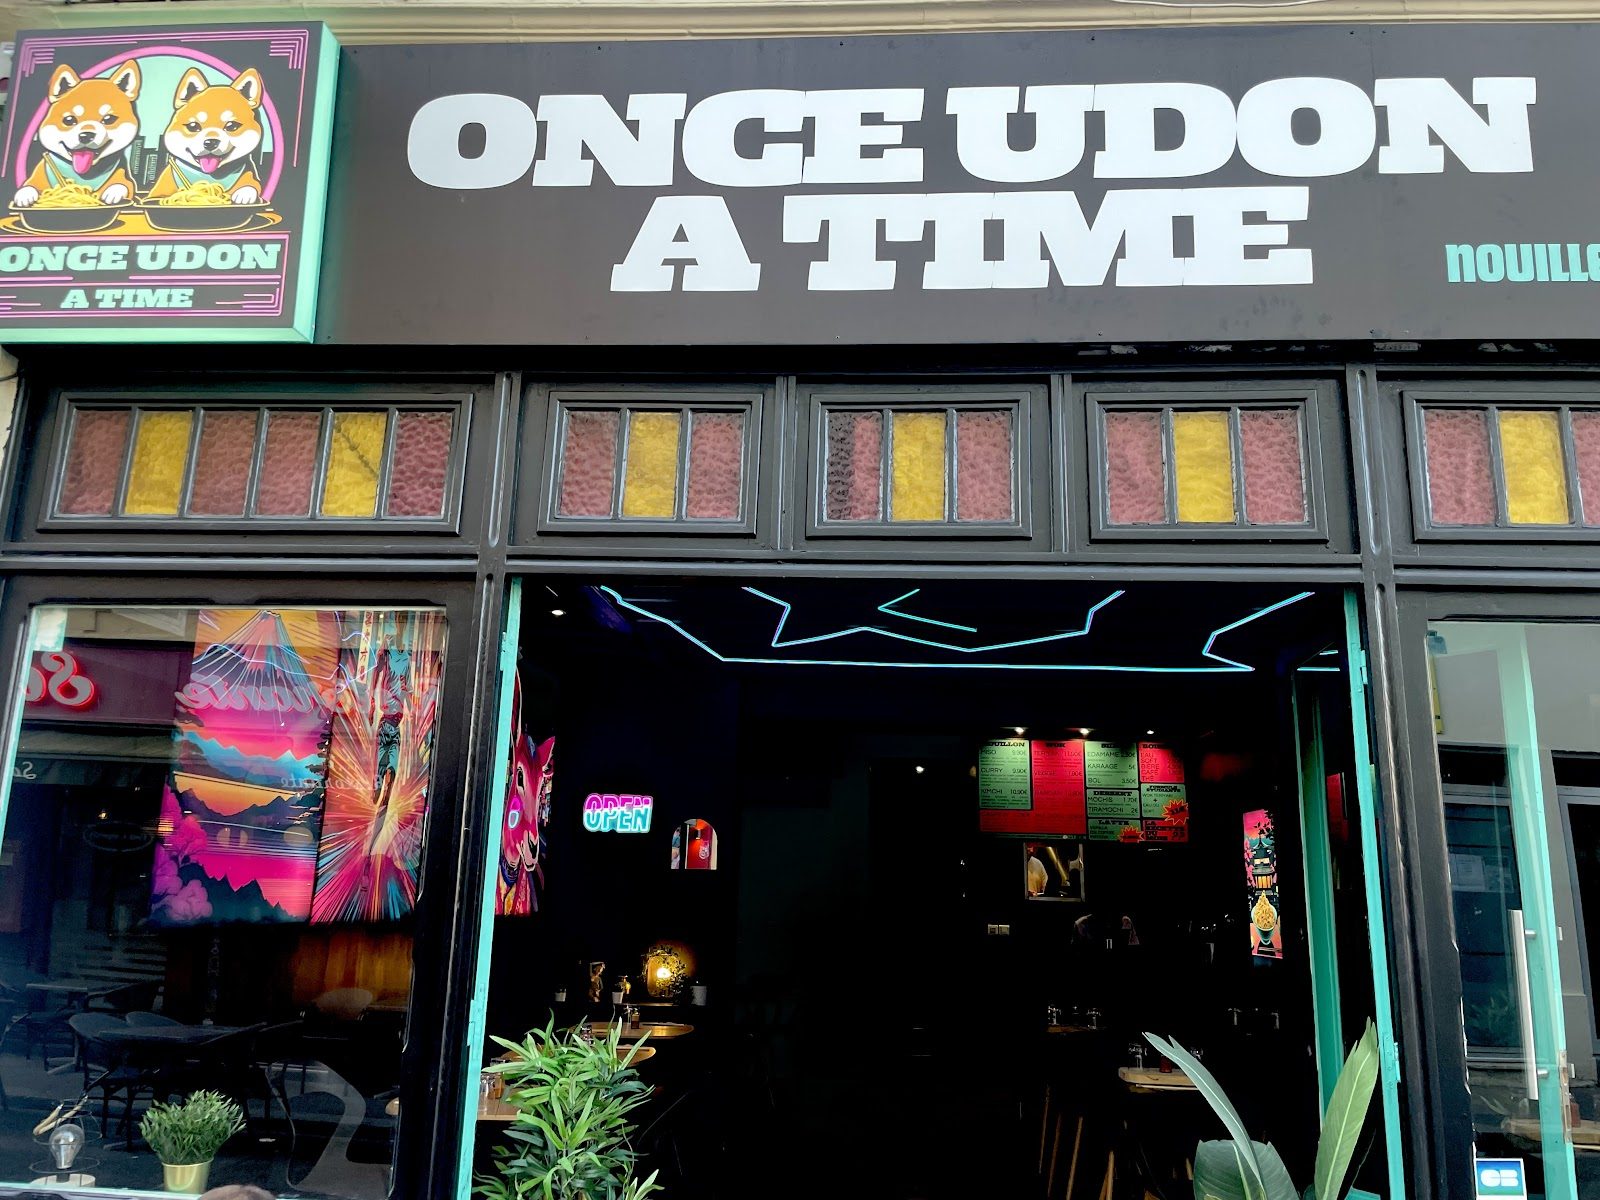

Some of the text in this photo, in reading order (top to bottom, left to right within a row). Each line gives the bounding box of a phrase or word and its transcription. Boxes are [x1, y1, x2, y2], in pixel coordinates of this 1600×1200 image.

[407, 76, 1537, 190] ONCE UDON
[610, 186, 1314, 292] A TIME
[0, 243, 281, 272] ONCE UDON
[60, 288, 194, 309] A TIME
[583, 793, 654, 834] OPEN
[1480, 1169, 1519, 1187] CB
